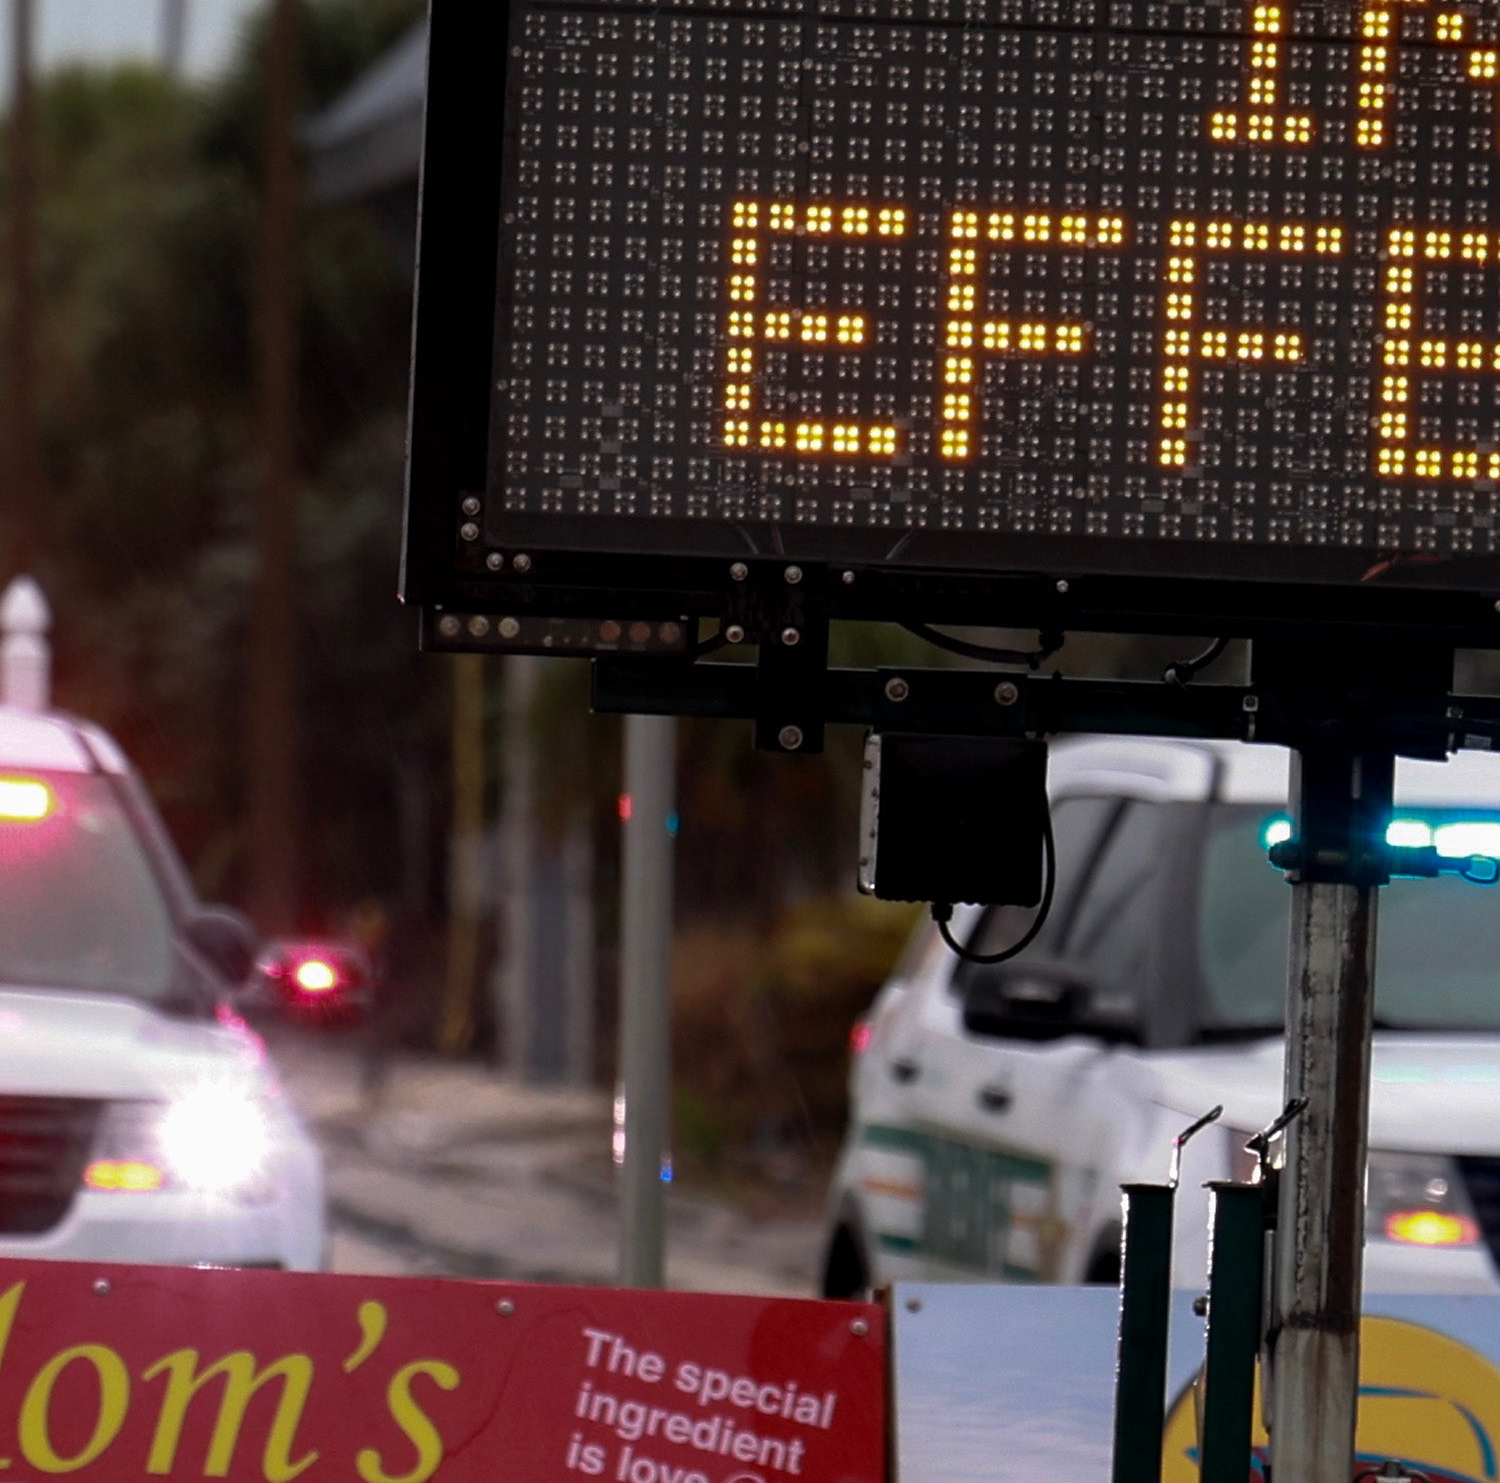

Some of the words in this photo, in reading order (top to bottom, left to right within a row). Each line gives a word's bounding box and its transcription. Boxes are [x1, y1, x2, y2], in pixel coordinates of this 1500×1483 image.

[581, 1327, 667, 1384] The
[674, 1360, 838, 1430] special
[565, 1432, 606, 1476] is
[574, 1381, 806, 1476] ingredient
